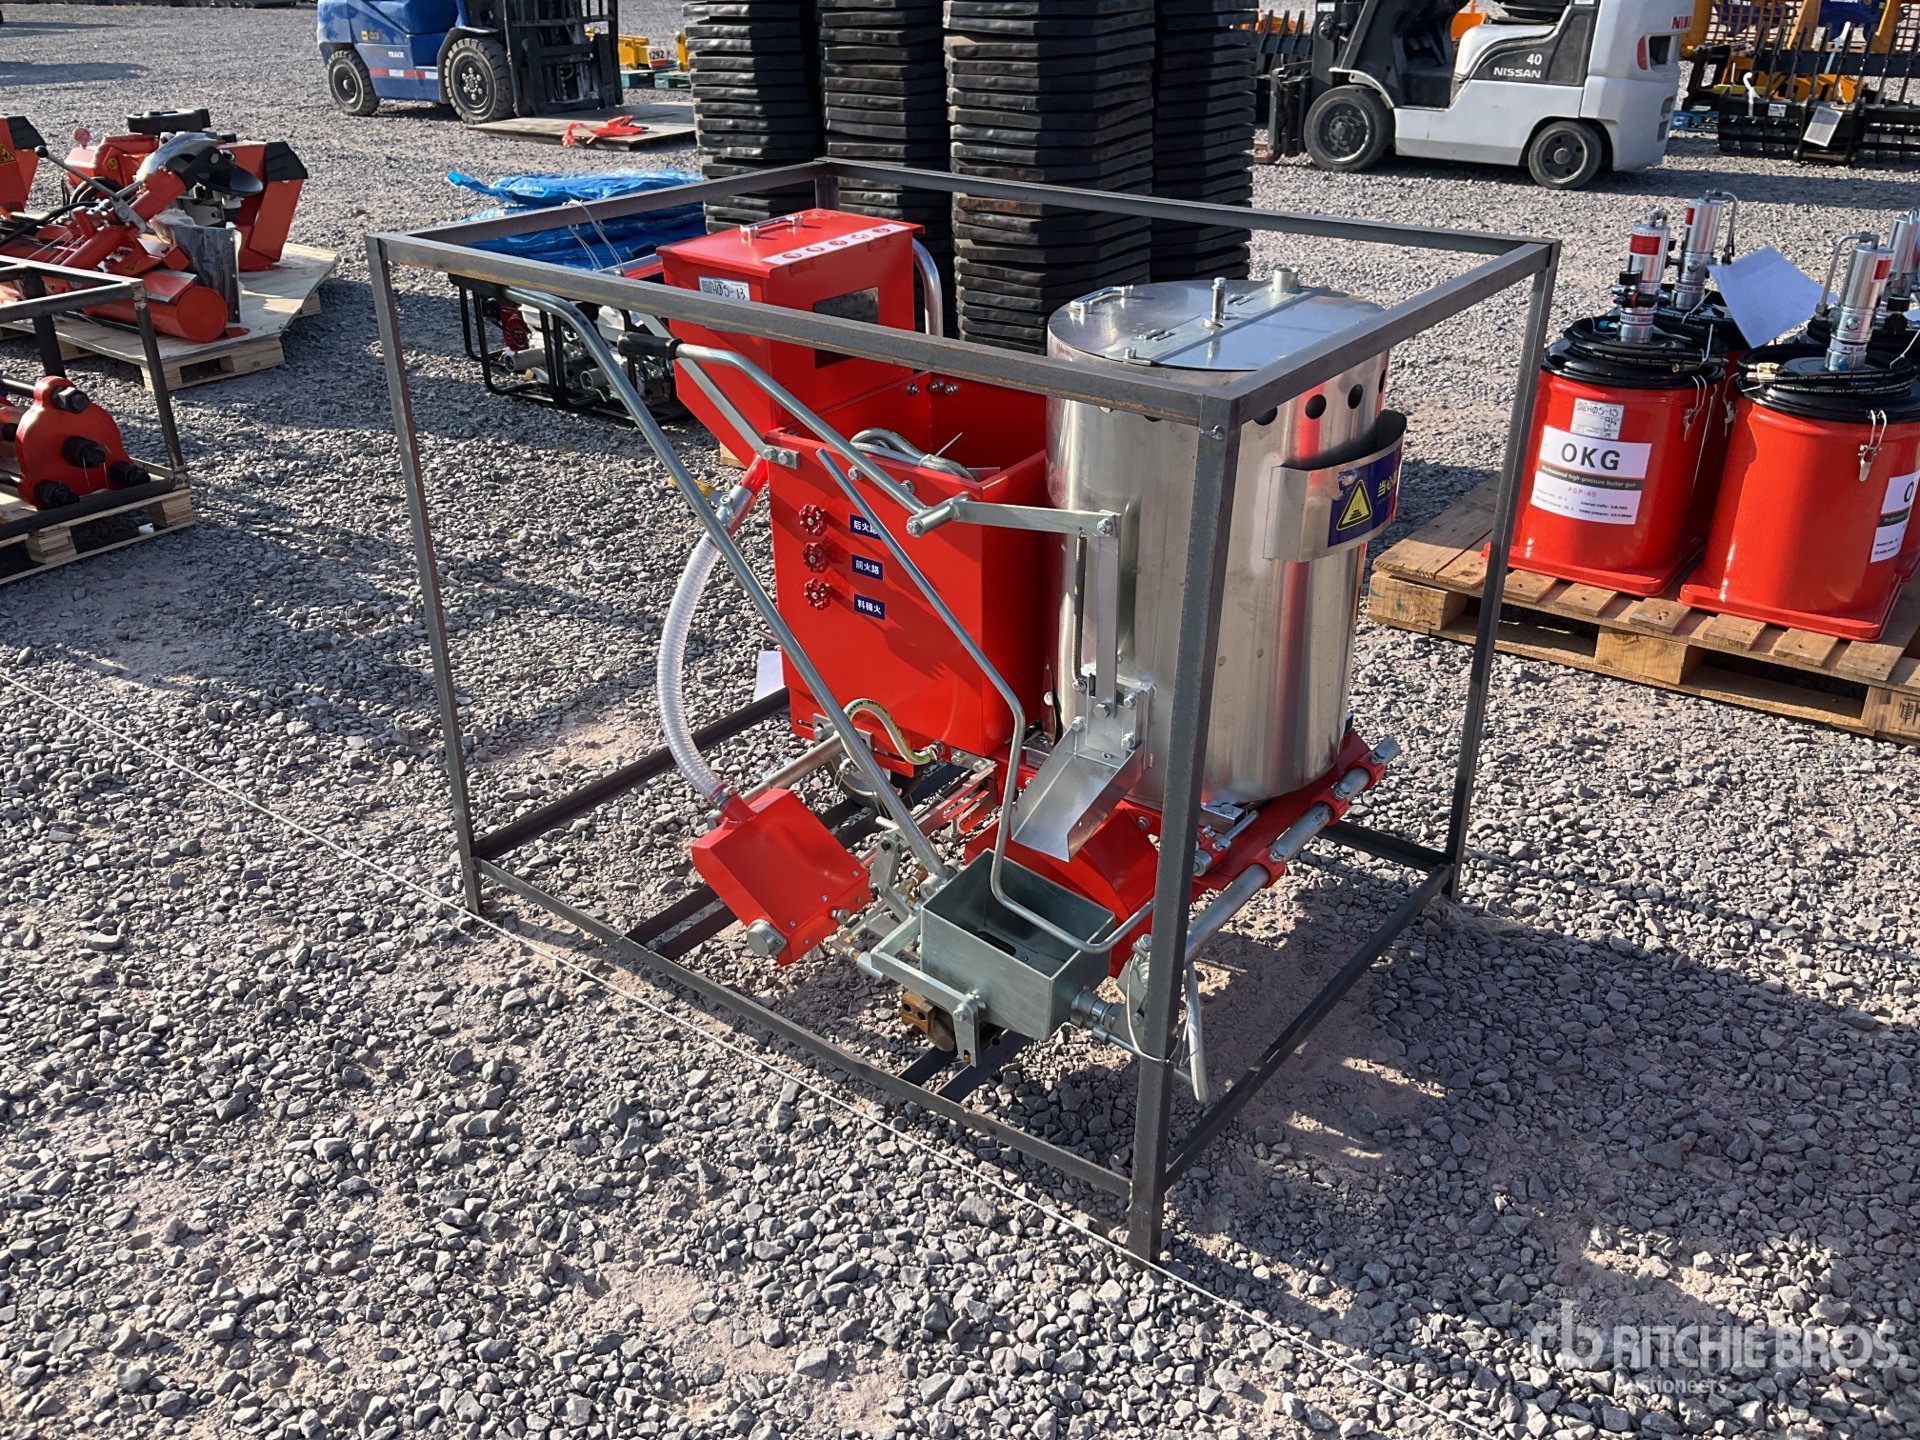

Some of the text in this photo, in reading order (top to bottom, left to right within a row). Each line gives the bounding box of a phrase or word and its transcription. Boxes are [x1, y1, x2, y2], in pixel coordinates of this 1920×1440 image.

[1526, 53, 1542, 65] 40
[1493, 66, 1542, 79] NISSAN
[1561, 442, 1621, 471] OKG
[1541, 464, 1568, 478] Professional
[1568, 473, 1606, 486] high-pressure
[1606, 480, 1624, 488] butter
[1567, 486, 1597, 498] PGP-40
[855, 559, 880, 575] 前火路
